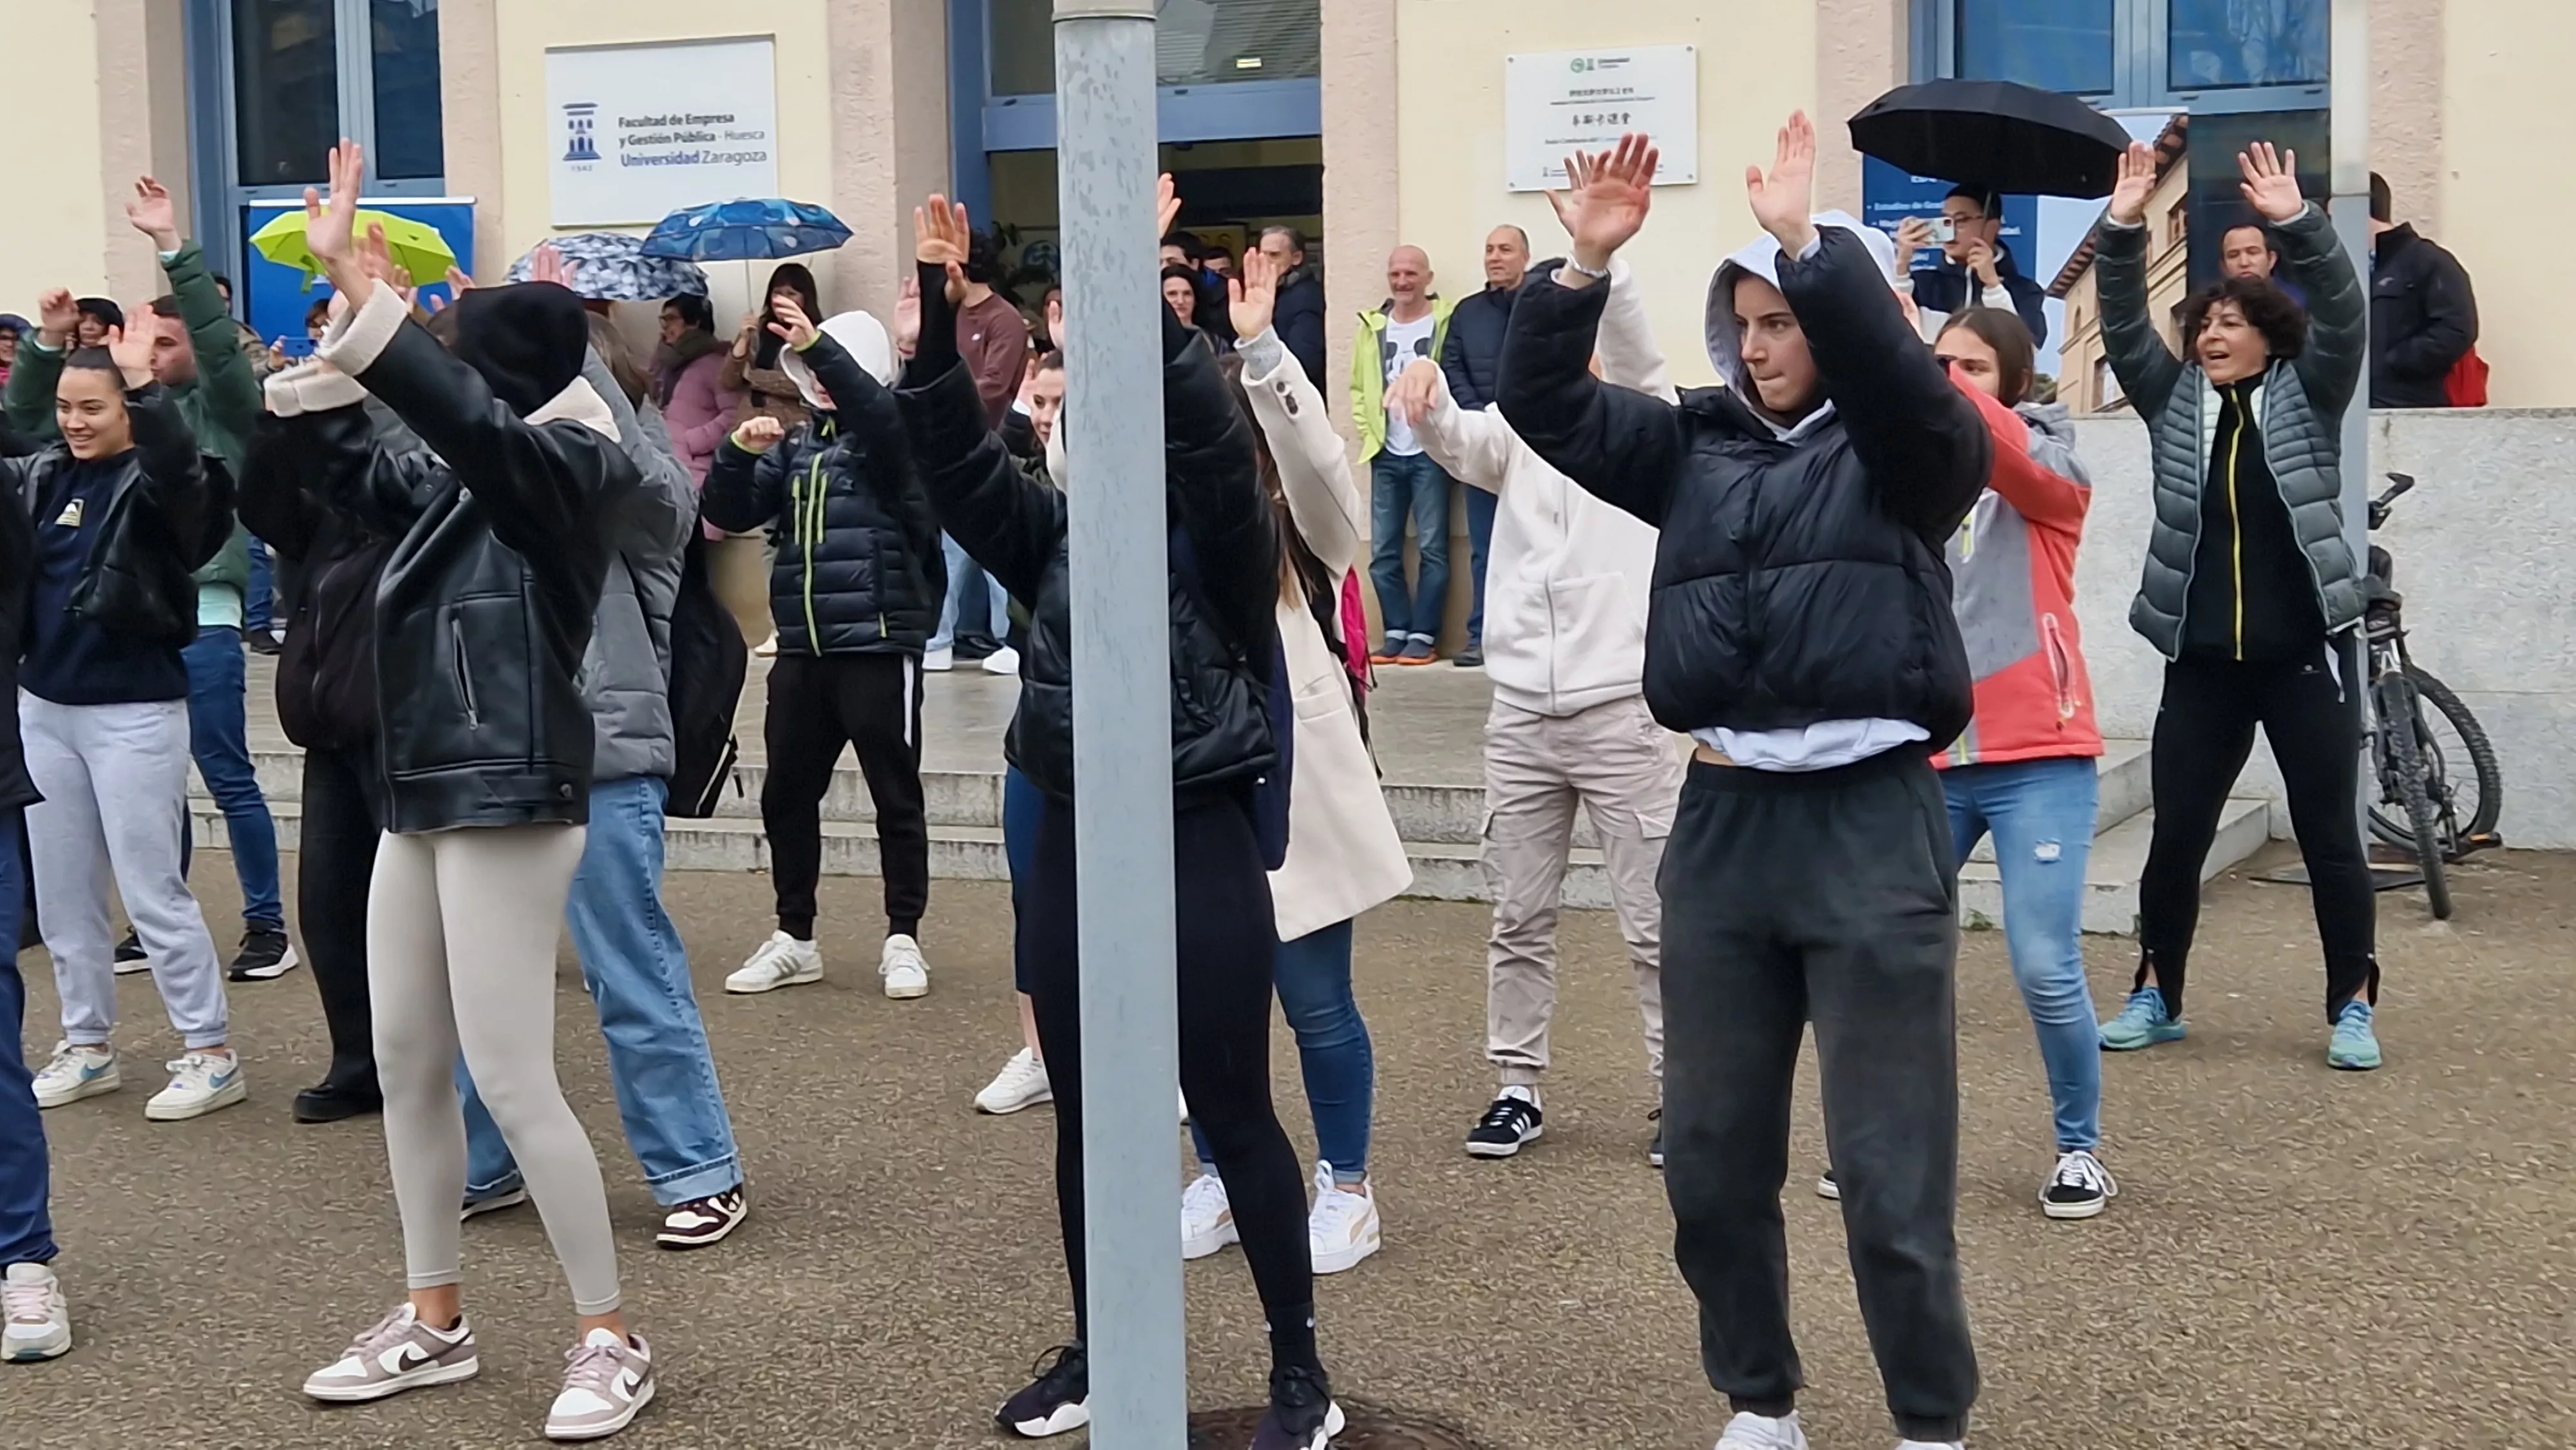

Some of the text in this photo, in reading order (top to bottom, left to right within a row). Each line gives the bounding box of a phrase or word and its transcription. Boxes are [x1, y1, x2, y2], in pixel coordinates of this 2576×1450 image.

[618, 113, 735, 128] Facultad de Empresa
[618, 137, 626, 149] y
[628, 132, 672, 146] Gestión
[673, 131, 716, 143] Pública
[724, 130, 765, 140] Huesca
[620, 149, 767, 167] Universidad Zaragoza
